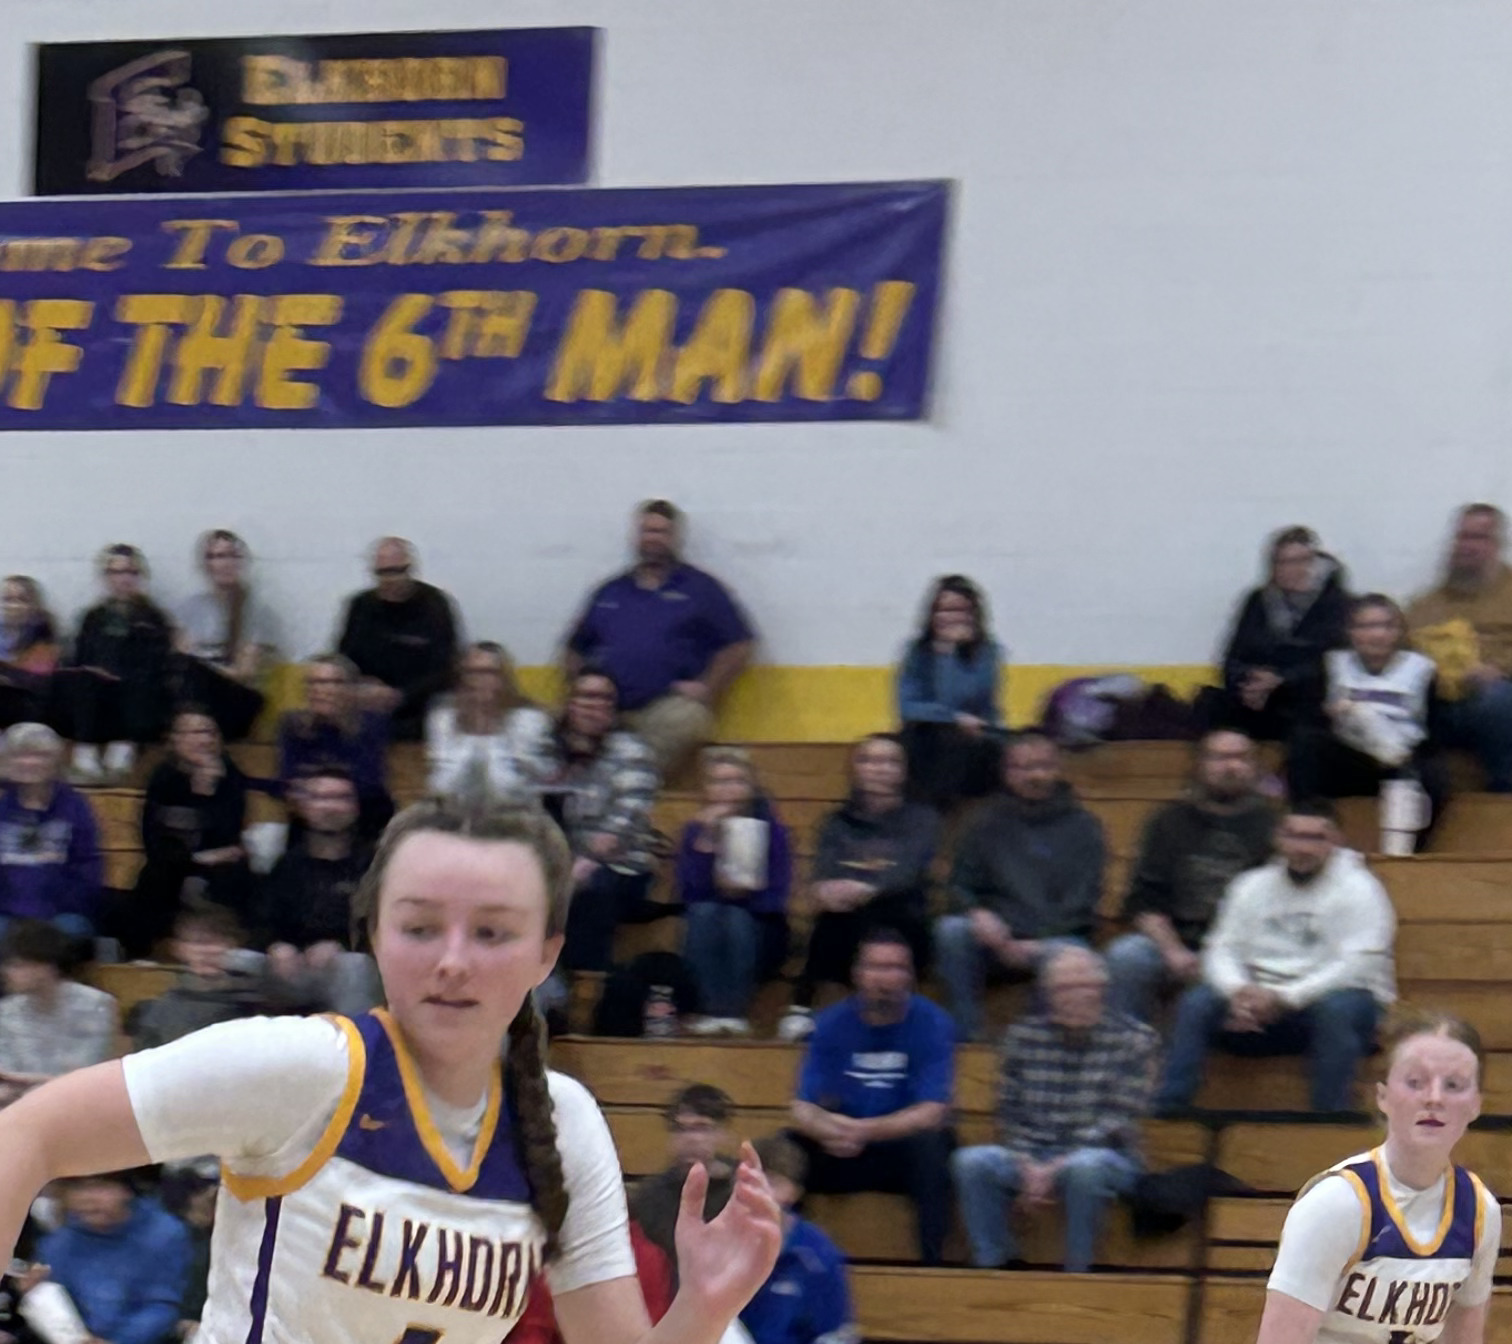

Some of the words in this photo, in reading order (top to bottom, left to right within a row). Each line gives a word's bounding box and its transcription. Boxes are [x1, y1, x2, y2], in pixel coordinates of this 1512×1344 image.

[161, 218, 285, 270] To
[114, 293, 344, 410] THE
[544, 280, 917, 403] MAN!
[1336, 1271, 1462, 1326] ELKHO
